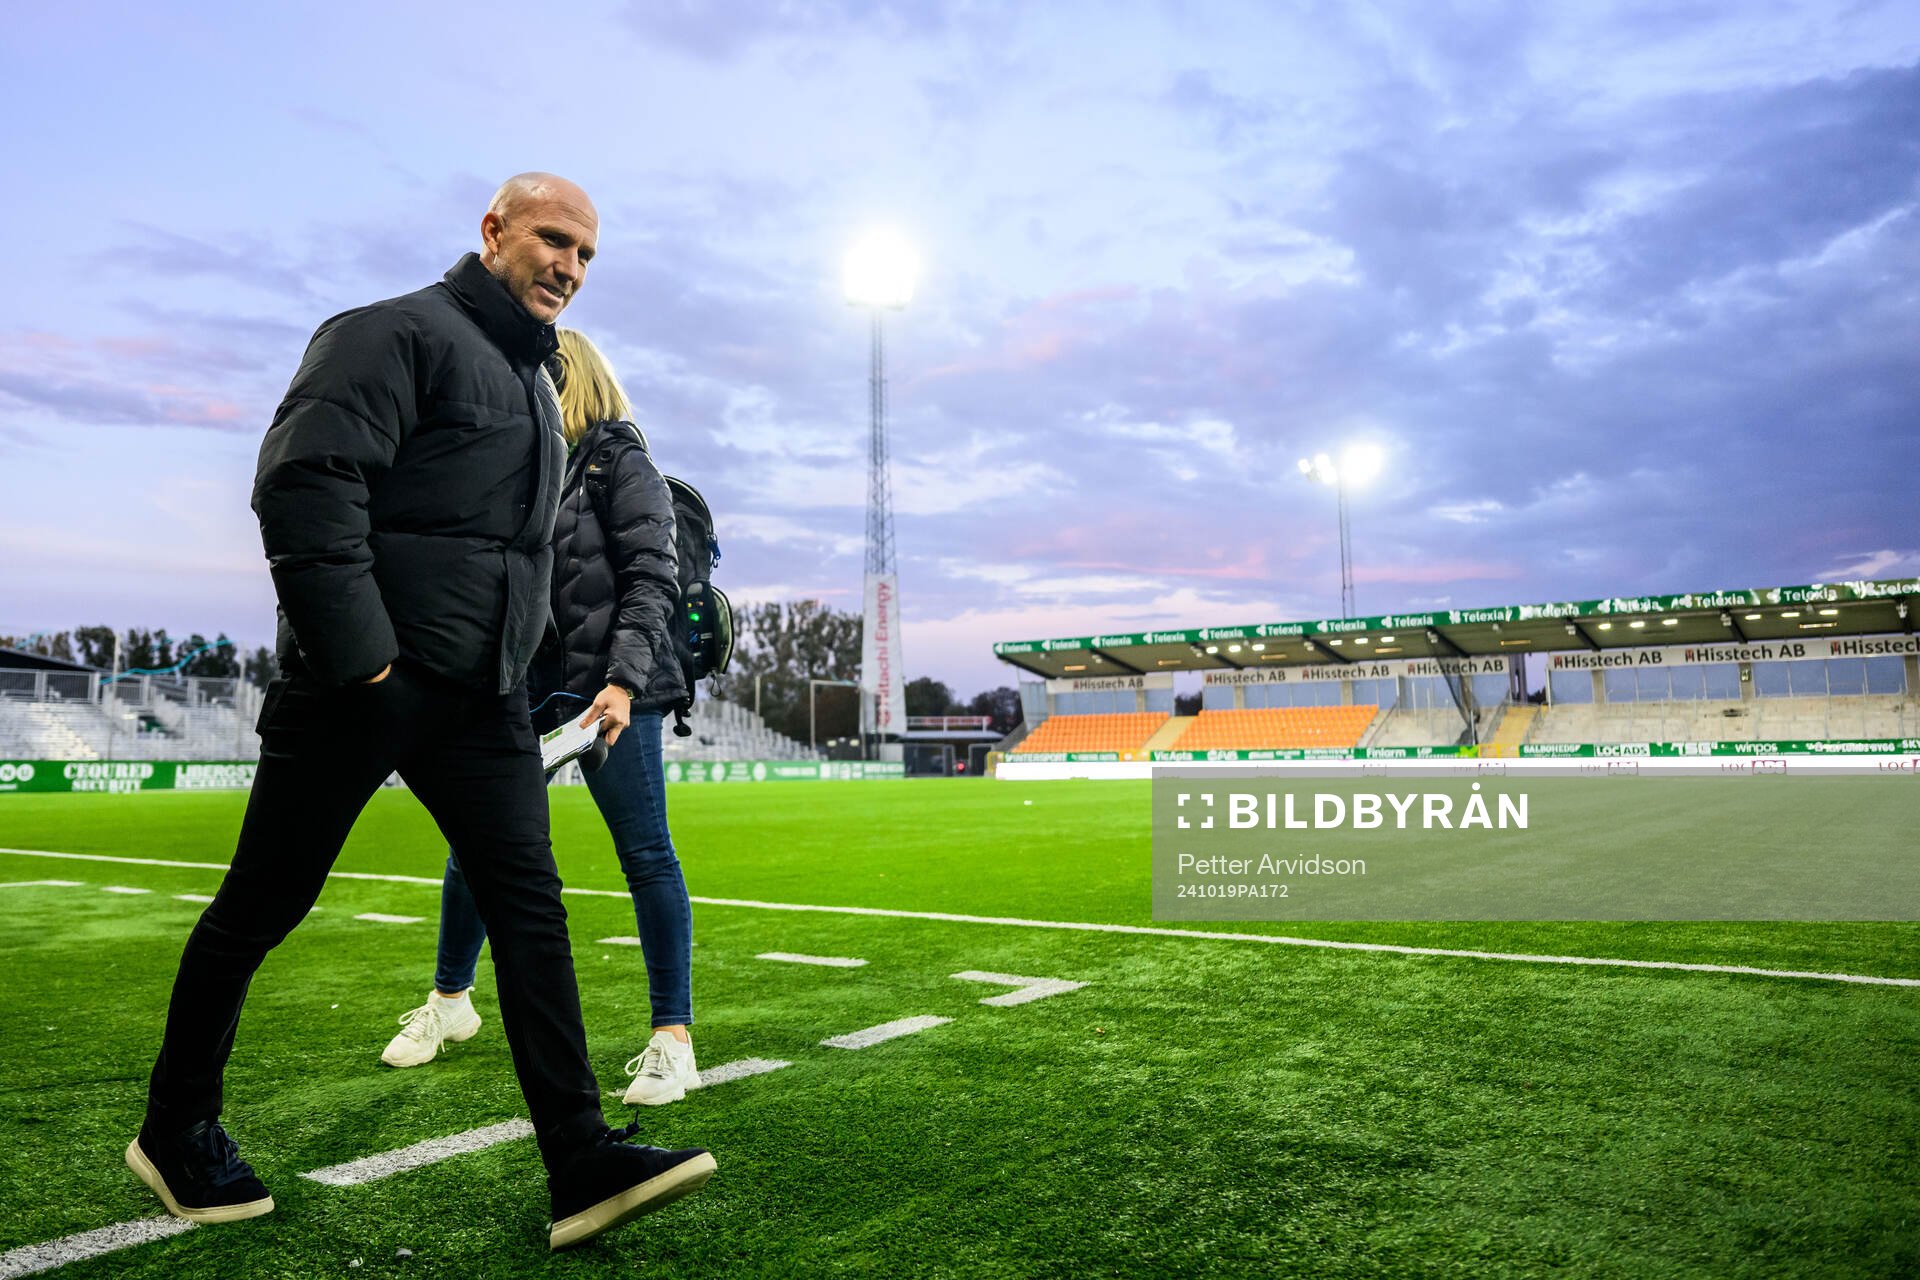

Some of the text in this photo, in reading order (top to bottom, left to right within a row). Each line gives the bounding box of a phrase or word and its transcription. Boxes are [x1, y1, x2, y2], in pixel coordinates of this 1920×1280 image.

[1694, 593, 1745, 608] Telexia
[1784, 587, 1838, 602] Telexia
[874, 583, 891, 642] Energy
[1462, 609, 1505, 623] Telexia
[1329, 619, 1367, 632] Telexia
[1395, 614, 1434, 628] Telexia
[1210, 628, 1243, 640] Telexia
[1268, 624, 1303, 636] Telexia
[1102, 636, 1132, 647] Telexia
[1154, 632, 1185, 643] Telexia
[1564, 650, 1662, 669] Hisstech AB
[1697, 643, 1805, 662] Hisstech AB
[1310, 665, 1390, 680] Hisstech AB
[1417, 659, 1503, 675] Hisstech AB
[1080, 677, 1144, 690] Hisstech AB
[1214, 670, 1286, 685] Hisstech AB
[1735, 741, 1777, 755] winpos
